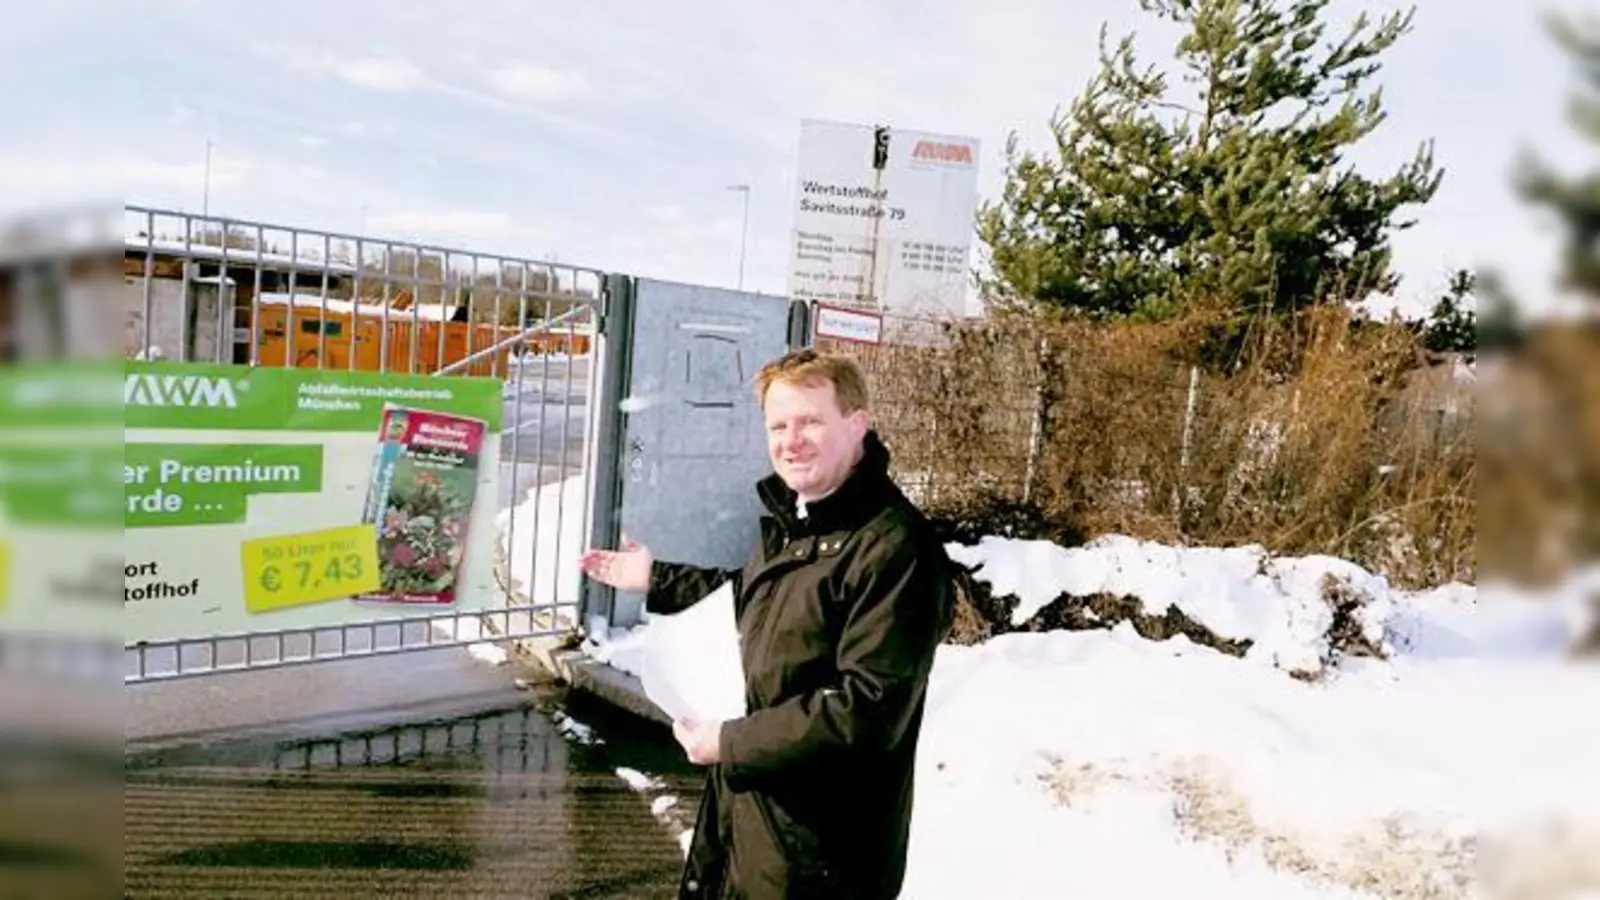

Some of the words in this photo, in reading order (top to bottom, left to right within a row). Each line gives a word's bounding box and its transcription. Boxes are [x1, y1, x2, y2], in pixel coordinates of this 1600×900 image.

[803, 181, 888, 200] Wertstoffhof
[800, 199, 886, 219] Savitsstraße
[889, 207, 906, 220] 79
[298, 397, 362, 411] München
[161, 459, 301, 484] Premium
[260, 564, 281, 592] €
[294, 553, 364, 588] 7,43
